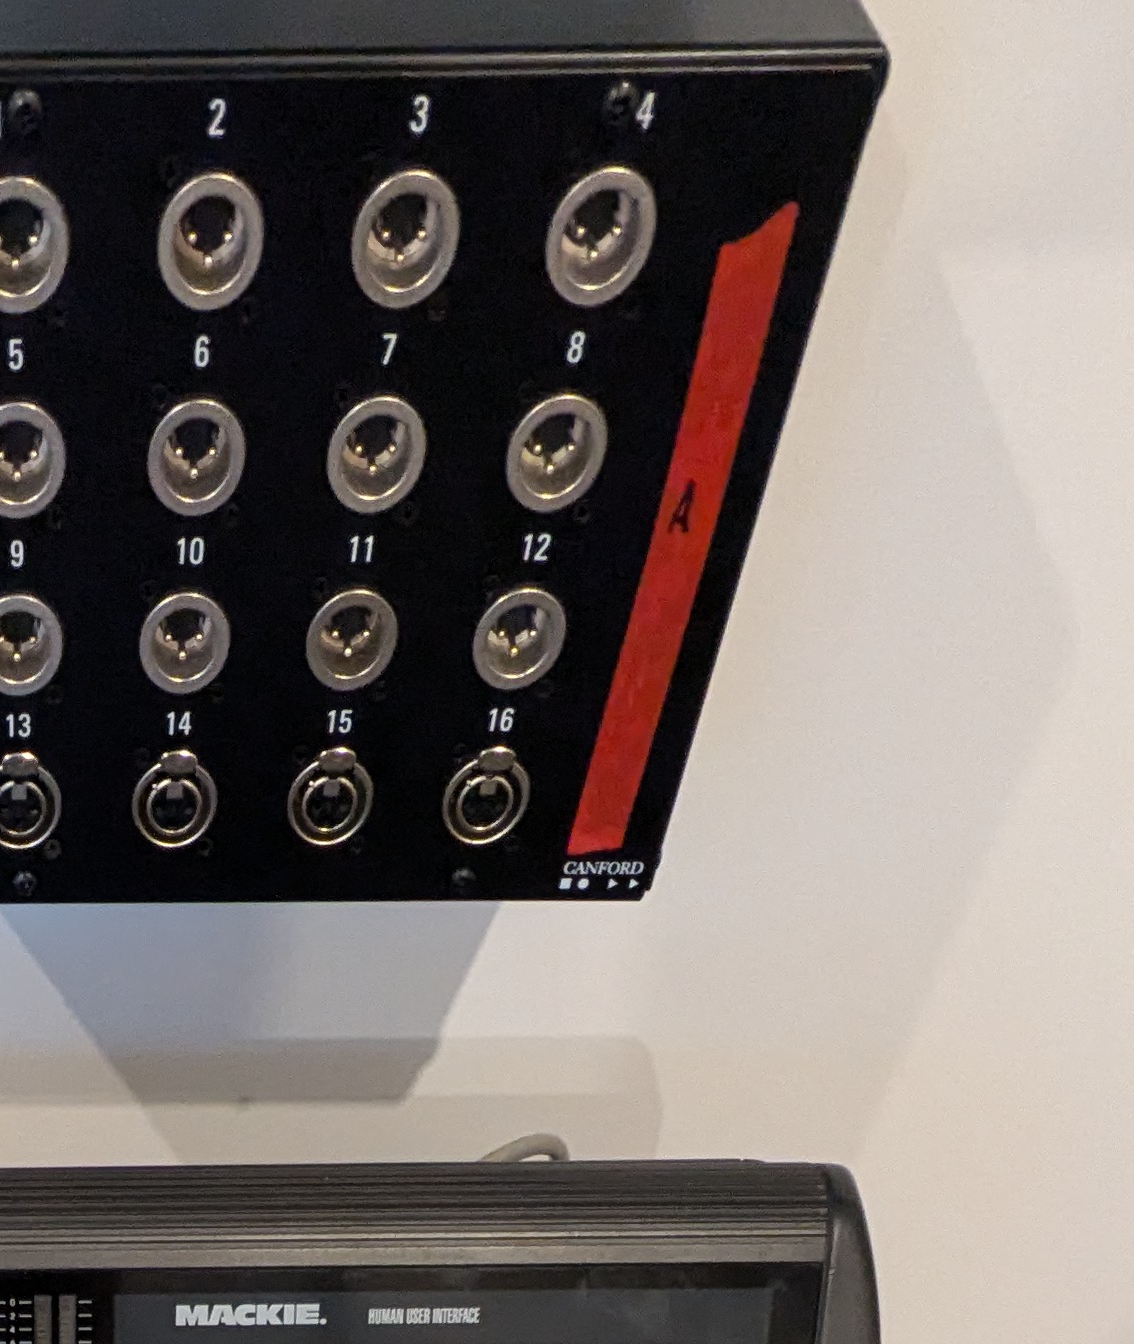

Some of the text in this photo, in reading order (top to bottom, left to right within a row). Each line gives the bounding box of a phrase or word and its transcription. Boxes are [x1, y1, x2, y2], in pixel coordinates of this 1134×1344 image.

[208, 100, 227, 137] 2
[410, 97, 429, 133] 3
[636, 93, 654, 128] 4
[8, 338, 23, 370] 5
[194, 337, 209, 367] 6
[381, 335, 397, 366] 7
[567, 332, 585, 364] 8
[9, 540, 23, 567] 9
[177, 537, 204, 565] 10
[350, 535, 374, 562] 11
[523, 533, 548, 561] 12
[6, 712, 30, 738] 13
[165, 711, 191, 736] 14
[327, 709, 353, 734] 15
[488, 707, 514, 732] 16
[563, 859, 644, 876] CANFORD
[368, 1307, 480, 1324] HUMAN USER INTERFACE
